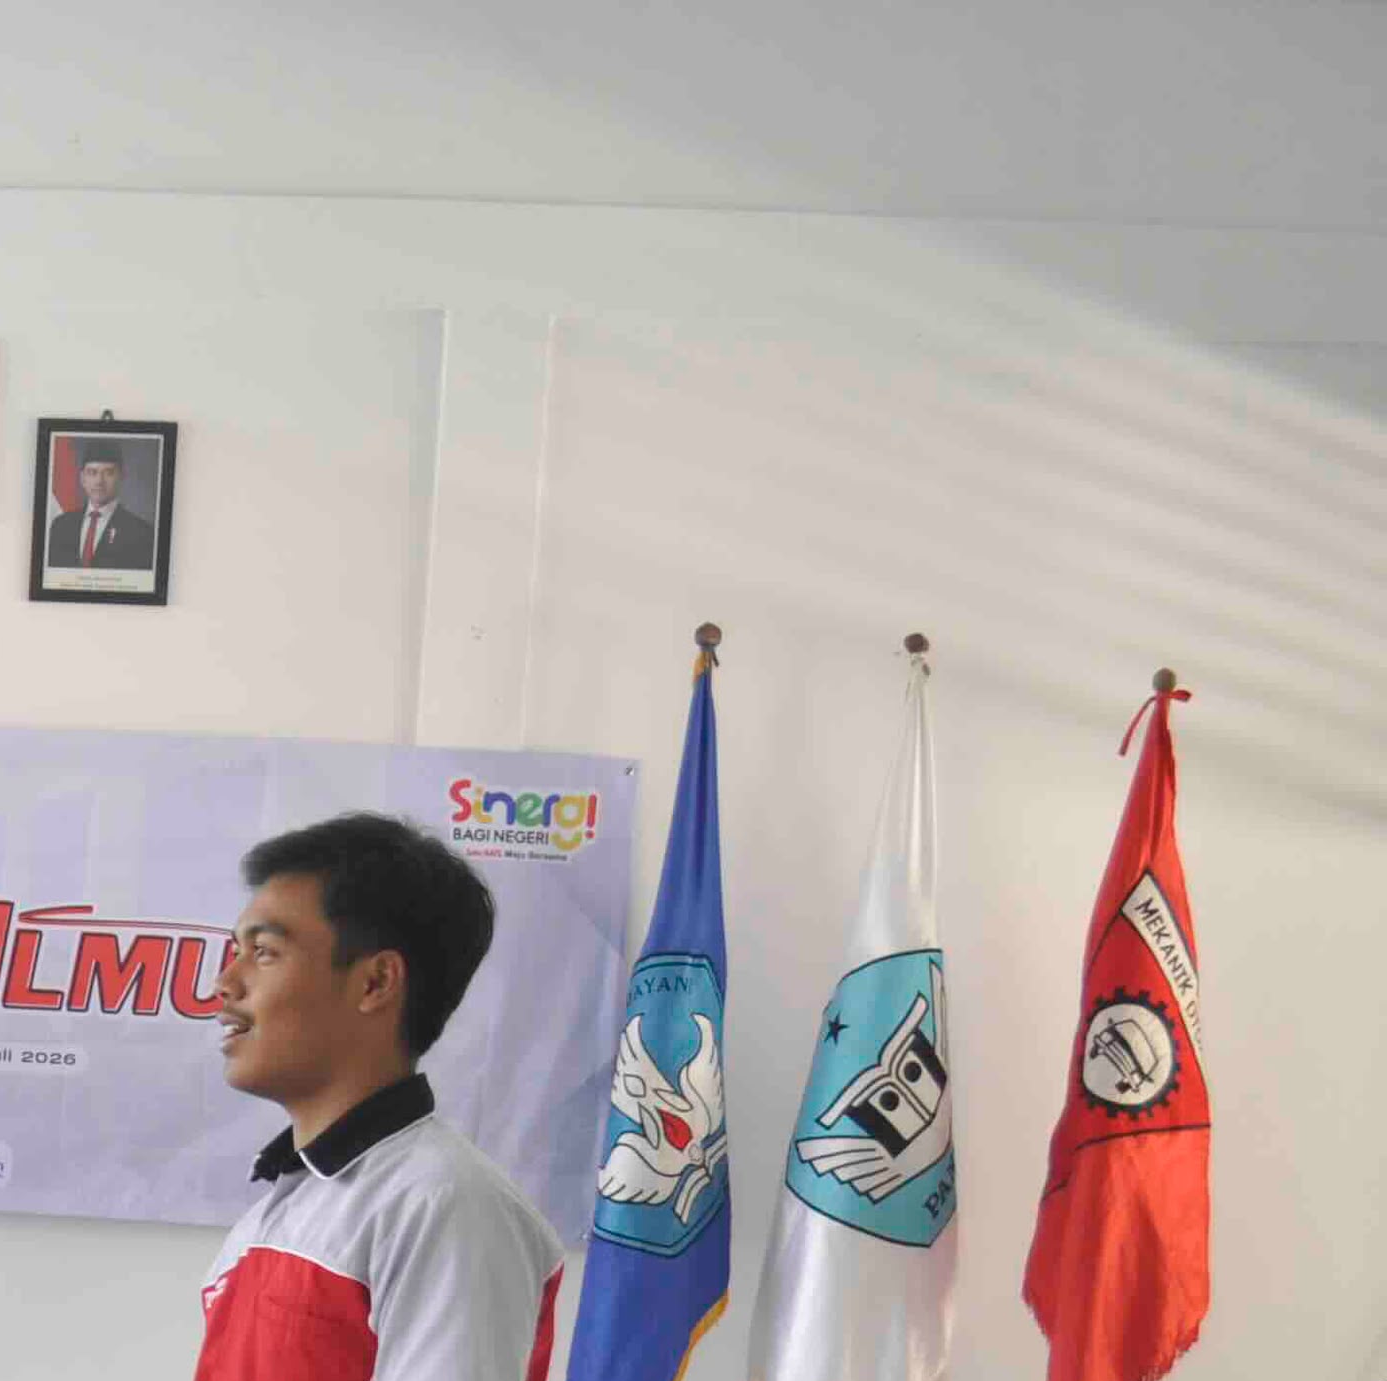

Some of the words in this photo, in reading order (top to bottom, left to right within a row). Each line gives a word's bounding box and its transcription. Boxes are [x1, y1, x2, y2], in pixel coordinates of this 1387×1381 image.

[453, 827, 491, 842] BAGI
[494, 829, 549, 845] NEGERI
[20, 1050, 77, 1066] 2026
